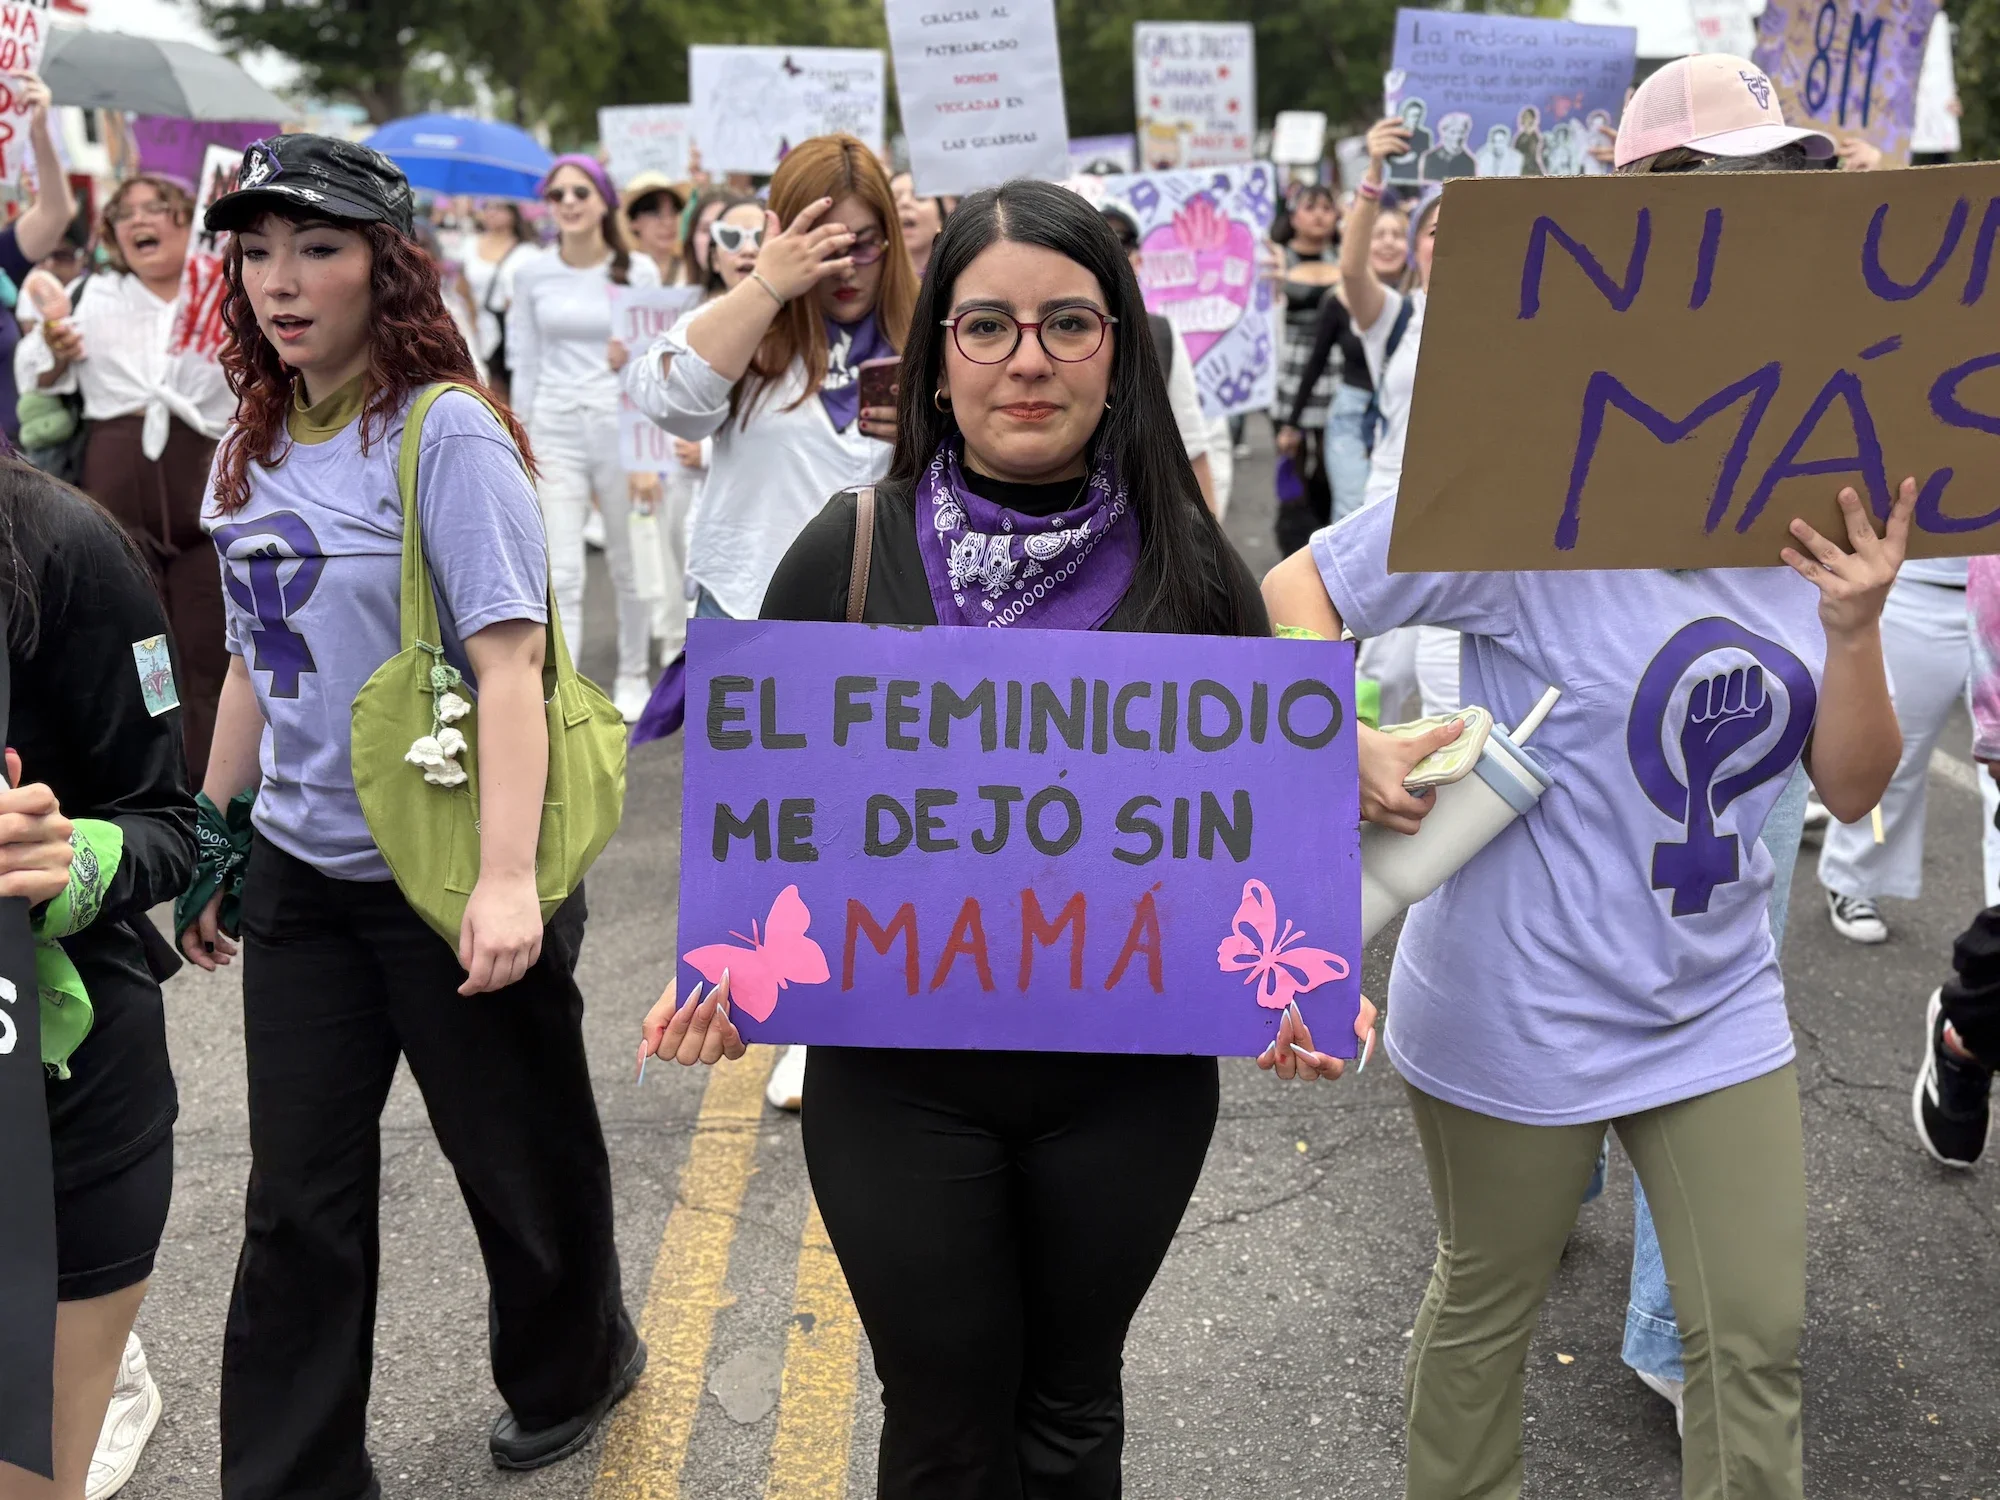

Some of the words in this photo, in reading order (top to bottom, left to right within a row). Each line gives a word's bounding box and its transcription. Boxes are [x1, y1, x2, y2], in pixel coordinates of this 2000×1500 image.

[921, 10, 979, 25] GRACIAS
[991, 6, 1009, 18] AL
[925, 38, 1018, 56] PATRIARCADO
[1412, 21, 1441, 46] La
[1454, 28, 1539, 47] medicina
[1806, 0, 1883, 128] 8M
[954, 73, 998, 85] SOMOS
[935, 98, 1000, 114] VIOLADAS
[1006, 97, 1023, 109] EN
[942, 139, 966, 151] LAS
[971, 132, 1037, 149] GUARDIAS
[1516, 206, 1725, 320] NI
[706, 675, 807, 750] EL
[833, 675, 1343, 754] FEMINICIDIO
[711, 797, 819, 863] ME
[863, 769, 1082, 857] DEJÓ
[1112, 789, 1253, 866] SIN
[841, 881, 1163, 996] MAMÁ
